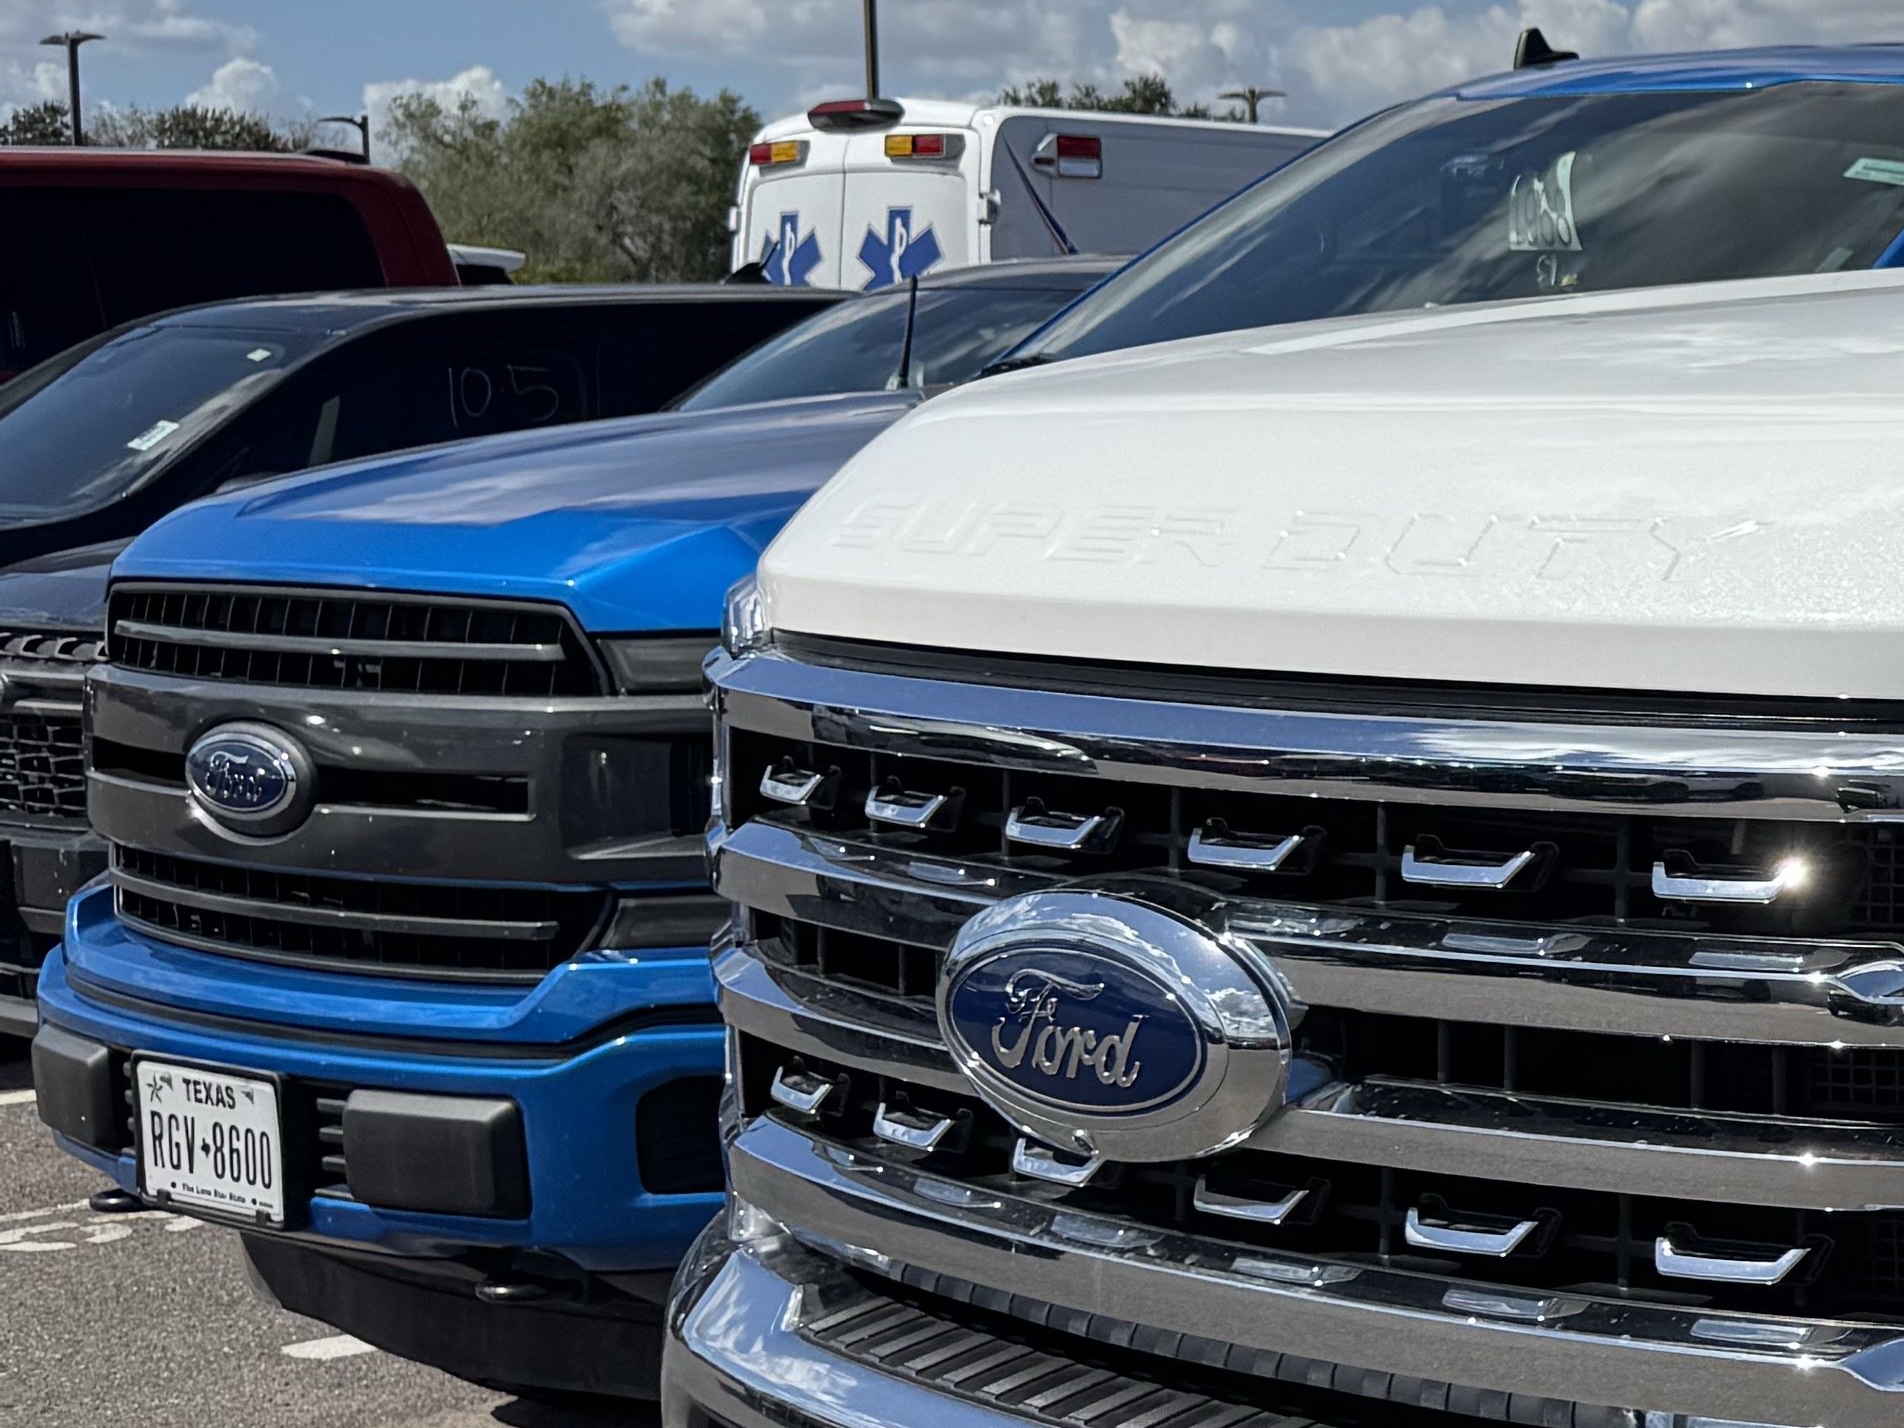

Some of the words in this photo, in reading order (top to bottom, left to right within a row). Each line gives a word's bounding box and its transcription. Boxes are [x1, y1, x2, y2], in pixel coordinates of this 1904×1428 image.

[831, 496, 1237, 569] SUPER
[1262, 508, 1776, 583] DUTY
[204, 750, 266, 803] Ford
[991, 967, 1151, 1089] Ford
[182, 1077, 236, 1110] TEXAS
